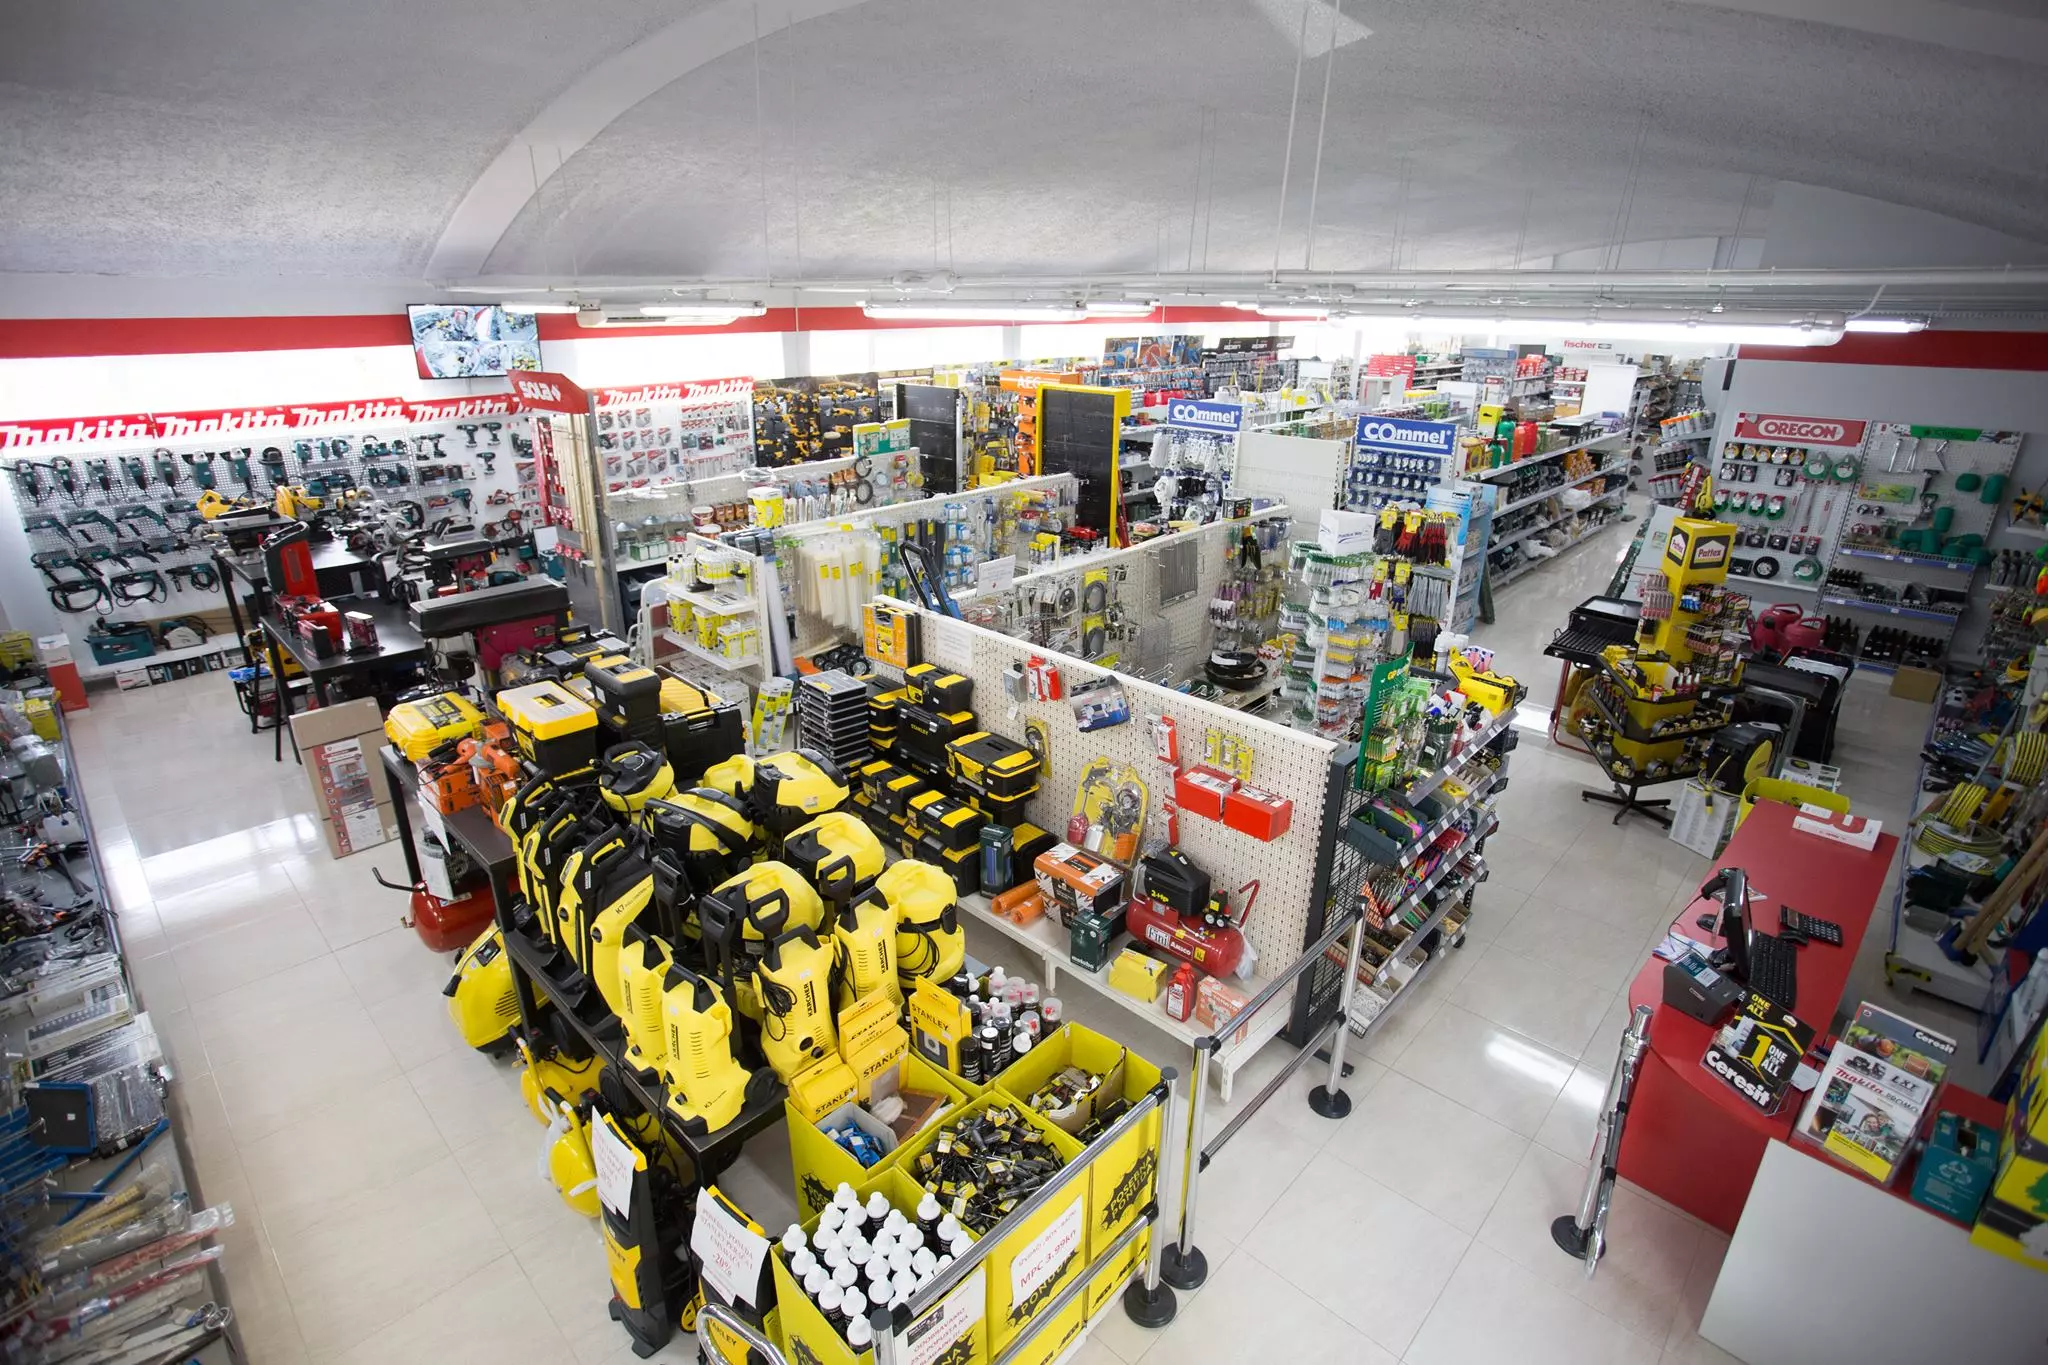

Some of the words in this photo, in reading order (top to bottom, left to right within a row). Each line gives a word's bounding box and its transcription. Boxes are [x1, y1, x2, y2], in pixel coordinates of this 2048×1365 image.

[1564, 339, 1597, 350] fischer
[1764, 421, 1838, 440] OREGON
[1698, 548, 1722, 557] Pattex
[1747, 1004, 1765, 1021] ALL
[1752, 994, 1772, 1009] ONE
[911, 1003, 949, 1032] STANLEY
[1769, 1045, 1788, 1064] ONE
[1915, 1031, 1955, 1055] Ceresit
[863, 1041, 907, 1079] STANLEY
[1761, 1060, 1783, 1078] ALL
[1706, 1050, 1771, 1106] Ceresit
[815, 1084, 856, 1116] STANLEY
[1110, 1155, 1152, 1211] POSEBNA
[1112, 1163, 1153, 1220] PONUDA
[712, 1253, 732, 1276] -20%
[1020, 1259, 1044, 1288] MPC
[709, 1318, 738, 1348] TANLEY
